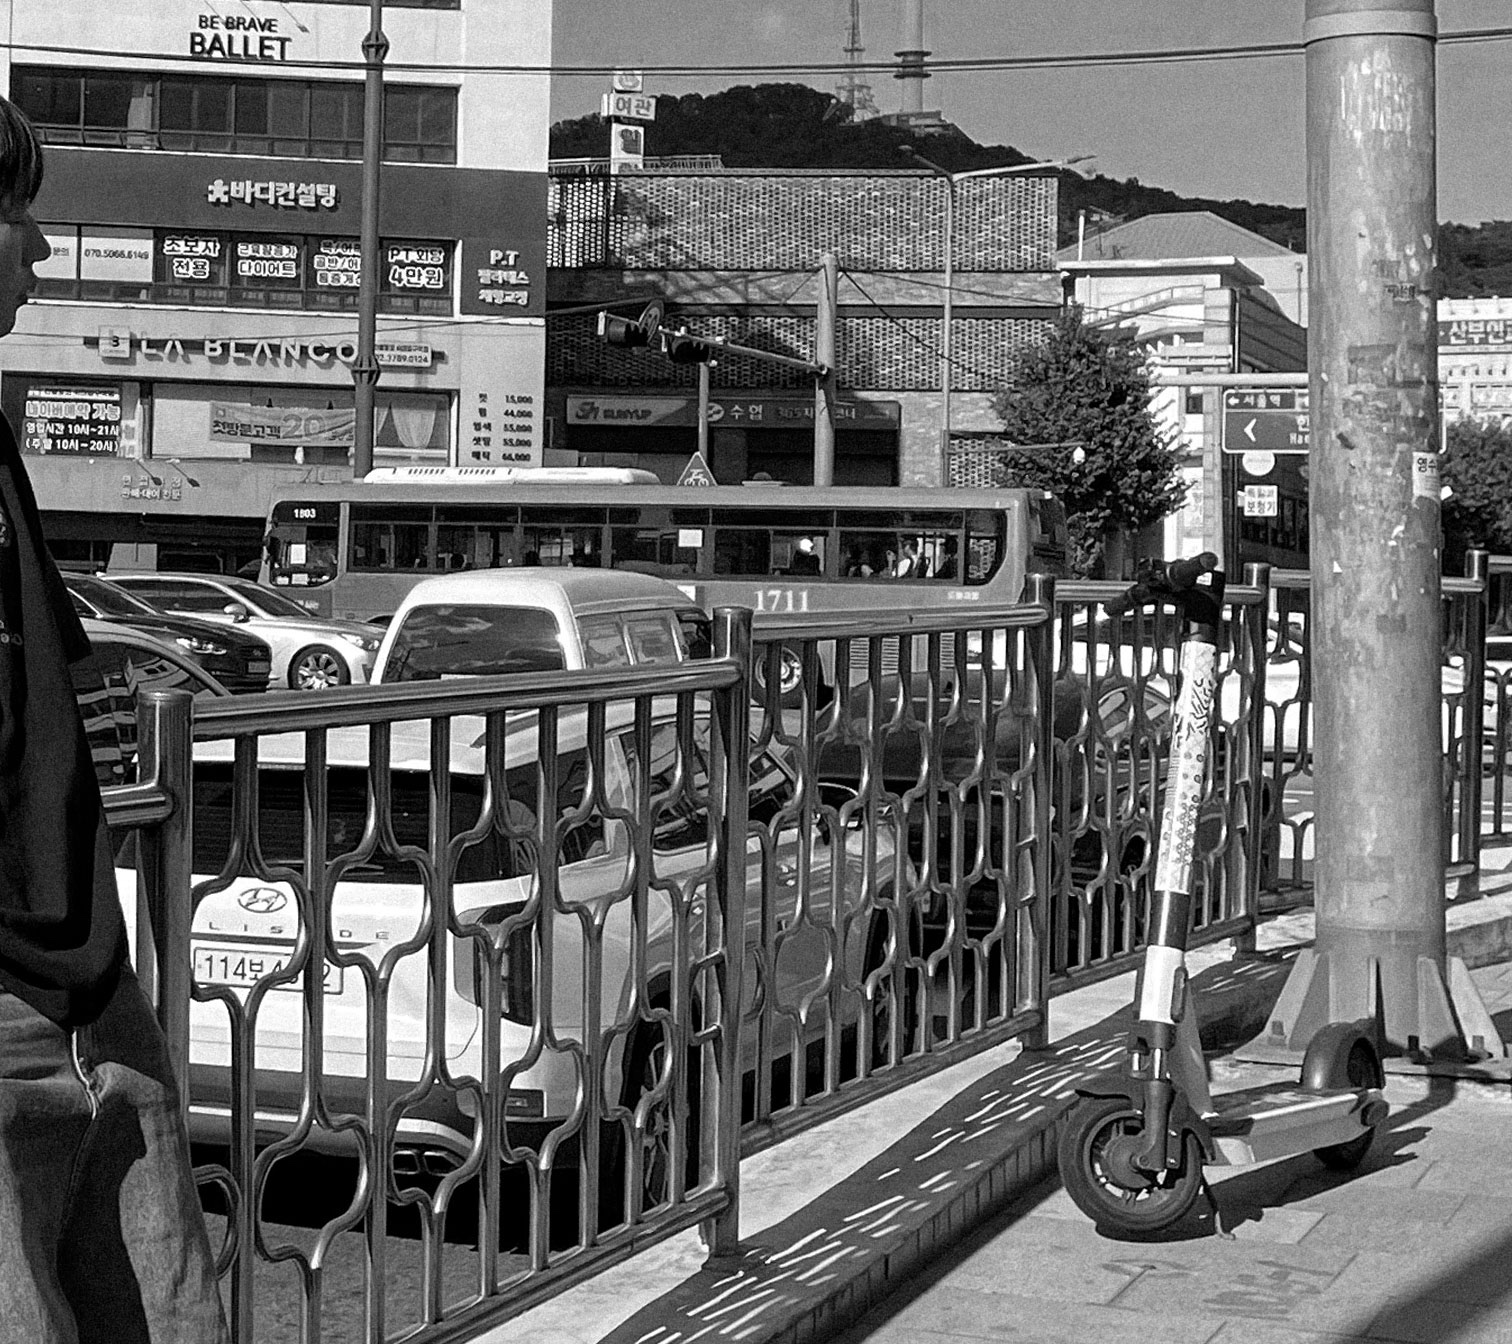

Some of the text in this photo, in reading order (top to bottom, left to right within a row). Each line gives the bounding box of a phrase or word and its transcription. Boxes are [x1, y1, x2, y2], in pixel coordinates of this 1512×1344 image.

[198, 14, 279, 33] BE BRAVE
[190, 32, 292, 61] BALLET
[616, 97, 651, 117] 여관
[230, 180, 337, 208] 바디컨설팅
[163, 236, 221, 257] 초보자
[388, 246, 410, 263] PT
[490, 249, 519, 266] P.T
[173, 258, 210, 279] 전용
[238, 260, 296, 277] 다이어트
[389, 265, 444, 288] 4만원
[141, 332, 359, 363] LA BLANCO
[730, 404, 763, 421] 수협
[754, 589, 809, 612] 1711
